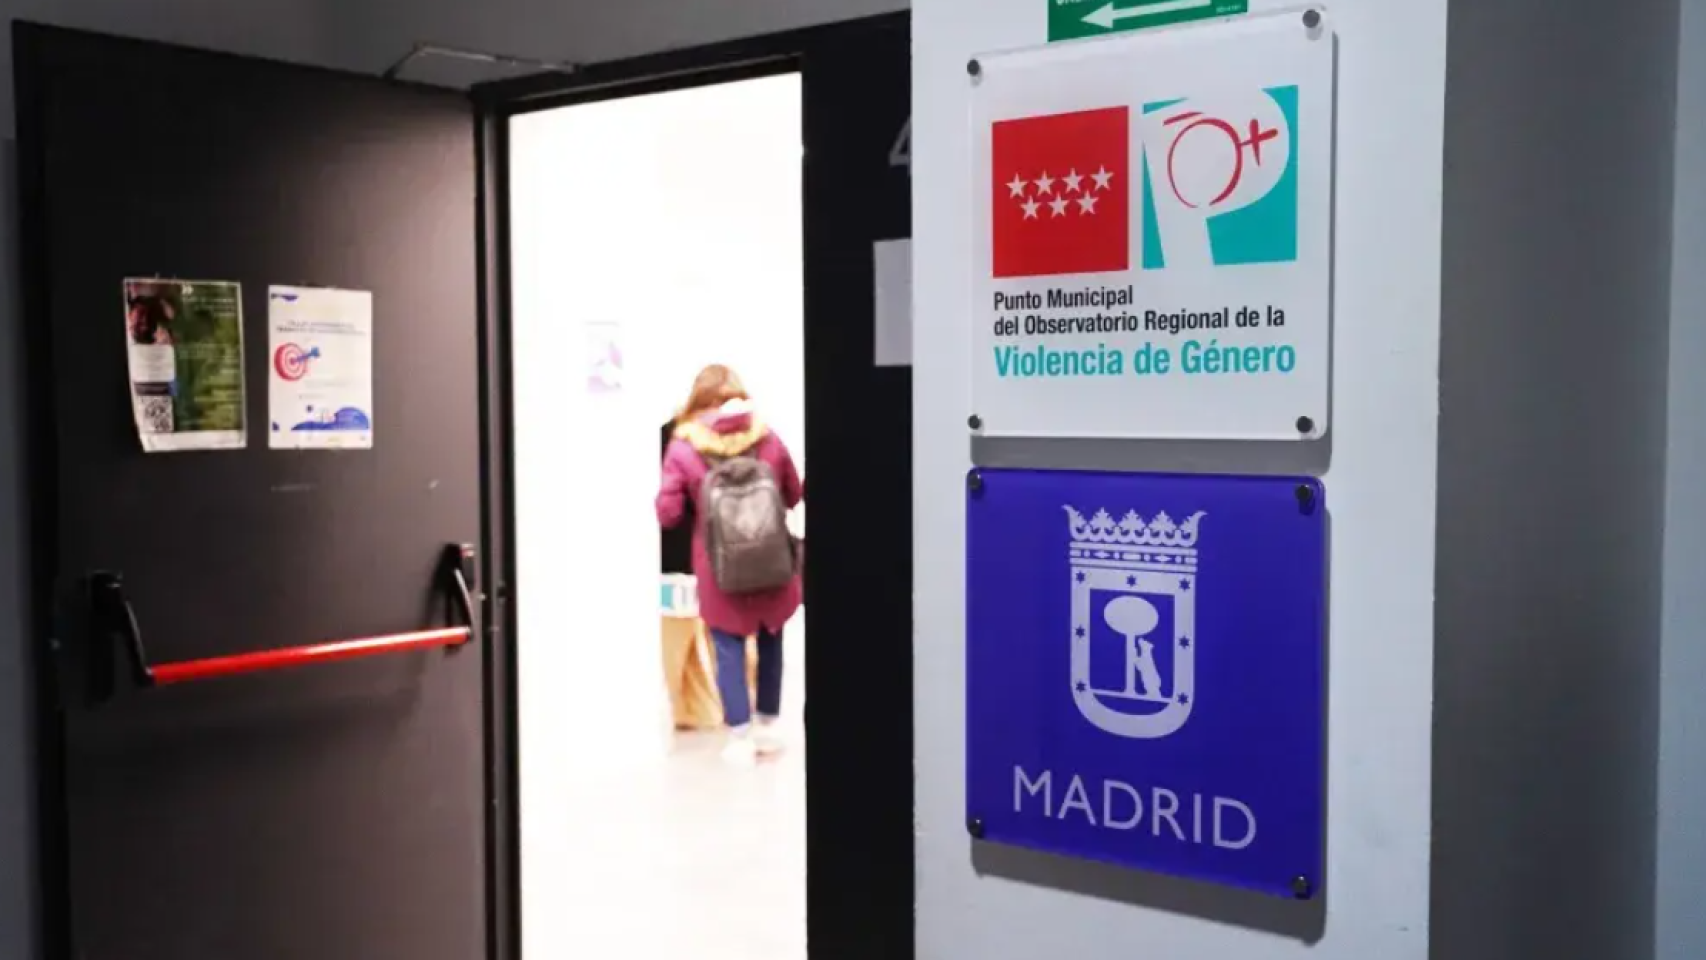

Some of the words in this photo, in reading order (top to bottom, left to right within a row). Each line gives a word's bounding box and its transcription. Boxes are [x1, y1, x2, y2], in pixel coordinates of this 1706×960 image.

[993, 291, 1042, 310] Punto
[1047, 285, 1133, 310] Municipal
[993, 315, 1019, 336] del
[1024, 311, 1138, 334] Observatorio
[1144, 306, 1229, 334] Regional
[1235, 307, 1260, 327] de
[1266, 305, 1285, 326] la
[993, 344, 1124, 377] Violencia
[1133, 342, 1171, 376] de
[1180, 339, 1297, 375] Género
[1013, 764, 1257, 850] MADRID
